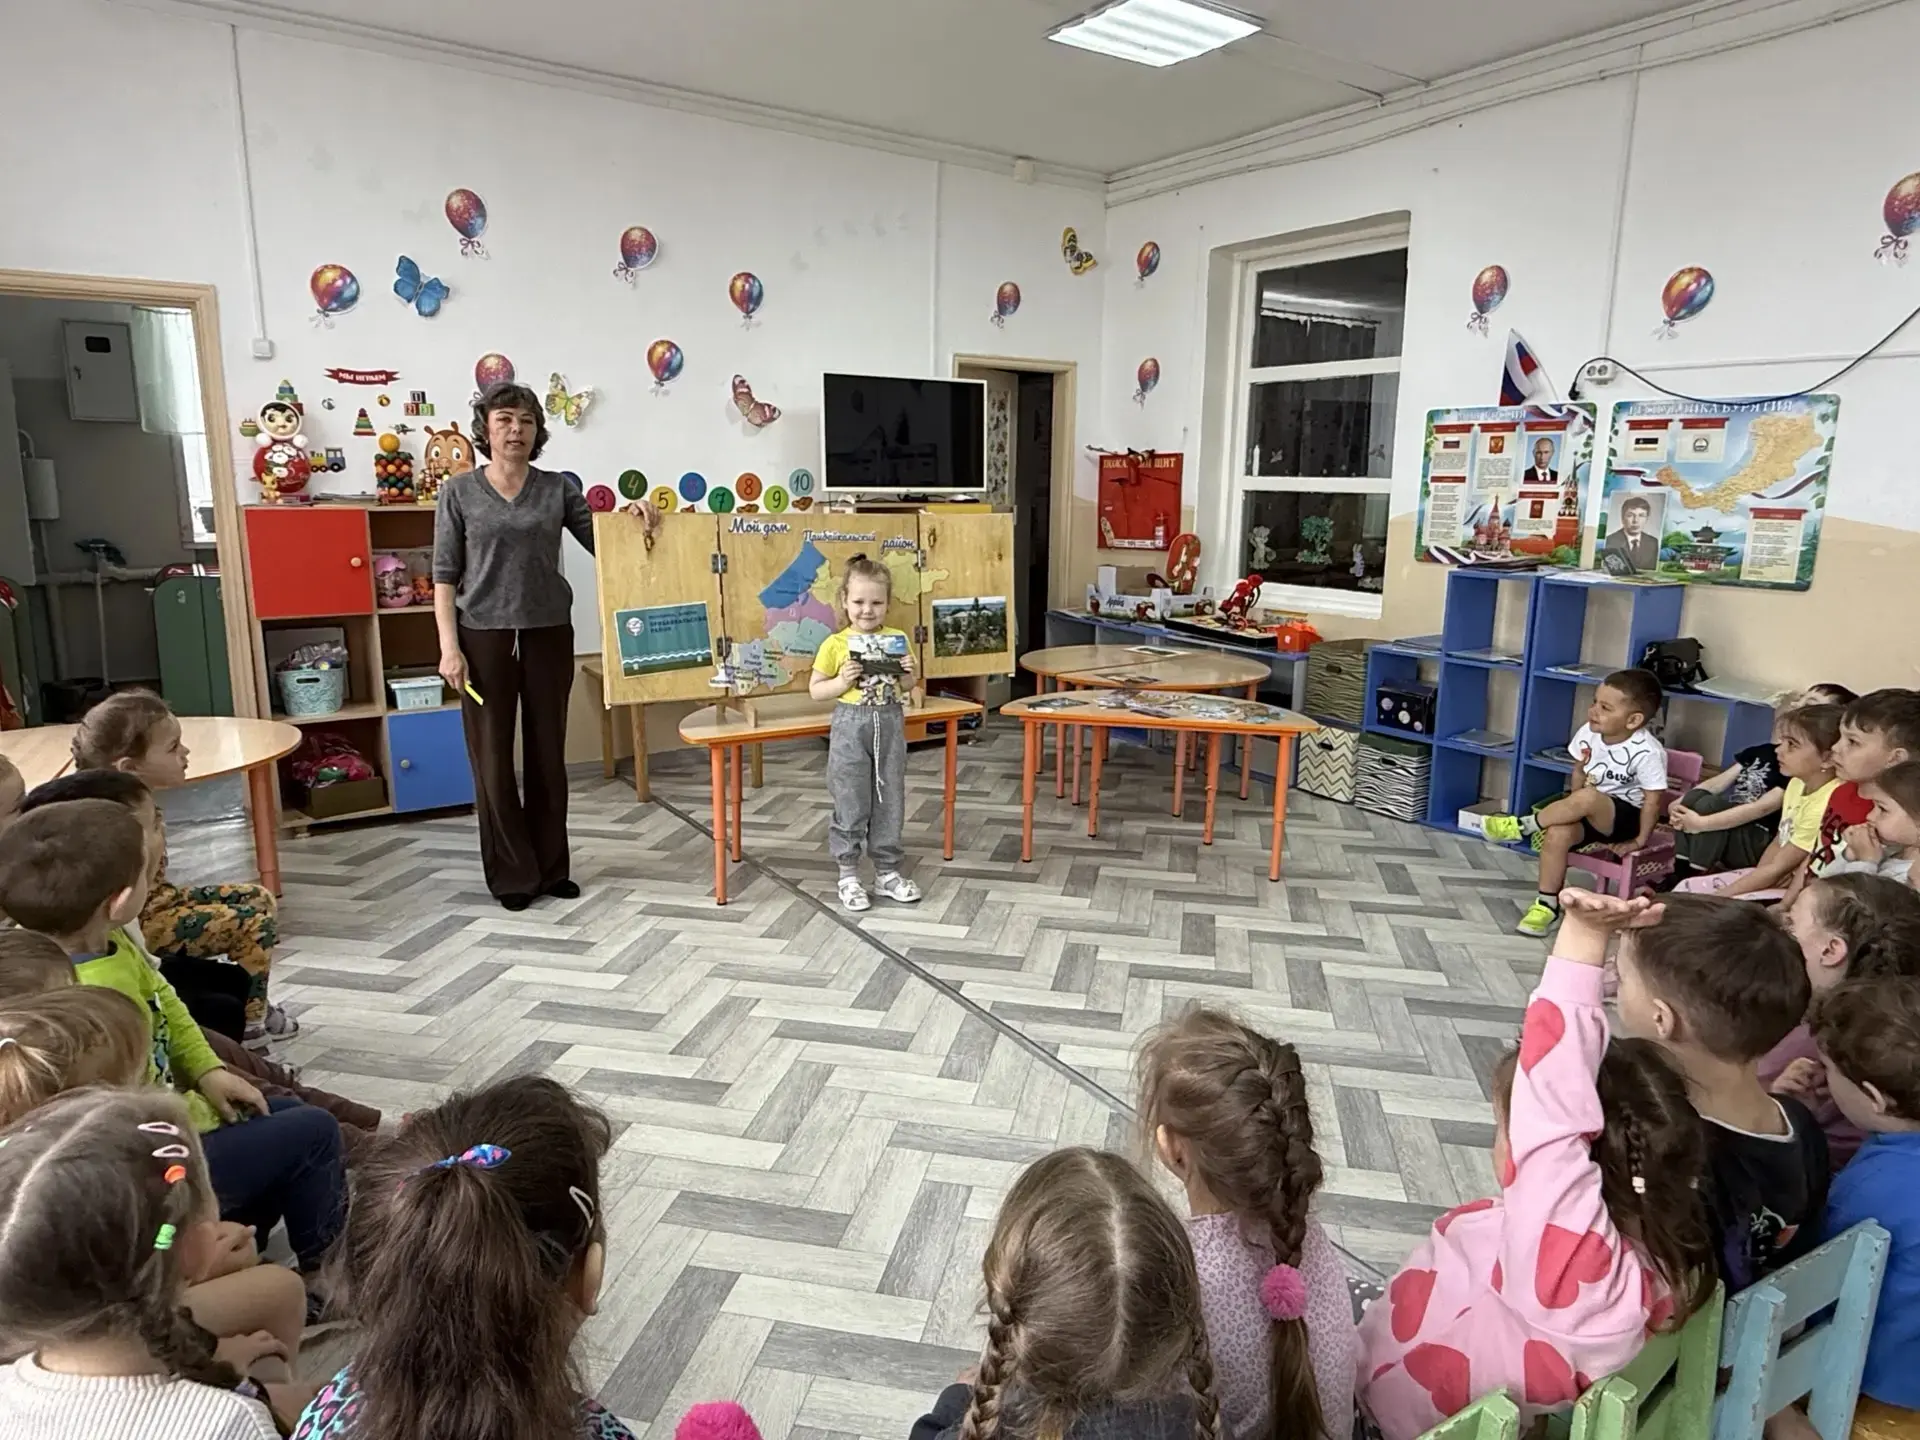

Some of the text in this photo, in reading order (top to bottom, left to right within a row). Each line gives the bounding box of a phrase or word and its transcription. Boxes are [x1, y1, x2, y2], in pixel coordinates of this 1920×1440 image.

[338, 372, 387, 382] МЫ ИГРАЕМ
[627, 474, 639, 495] 4
[743, 478, 754, 495] 8
[794, 472, 809, 491] 10
[595, 489, 607, 509] 3
[658, 491, 670, 510] 5
[715, 492, 725, 508] 7
[772, 490, 781, 508] 9
[728, 518, 789, 540] Мой дом
[880, 536, 916, 554] район
